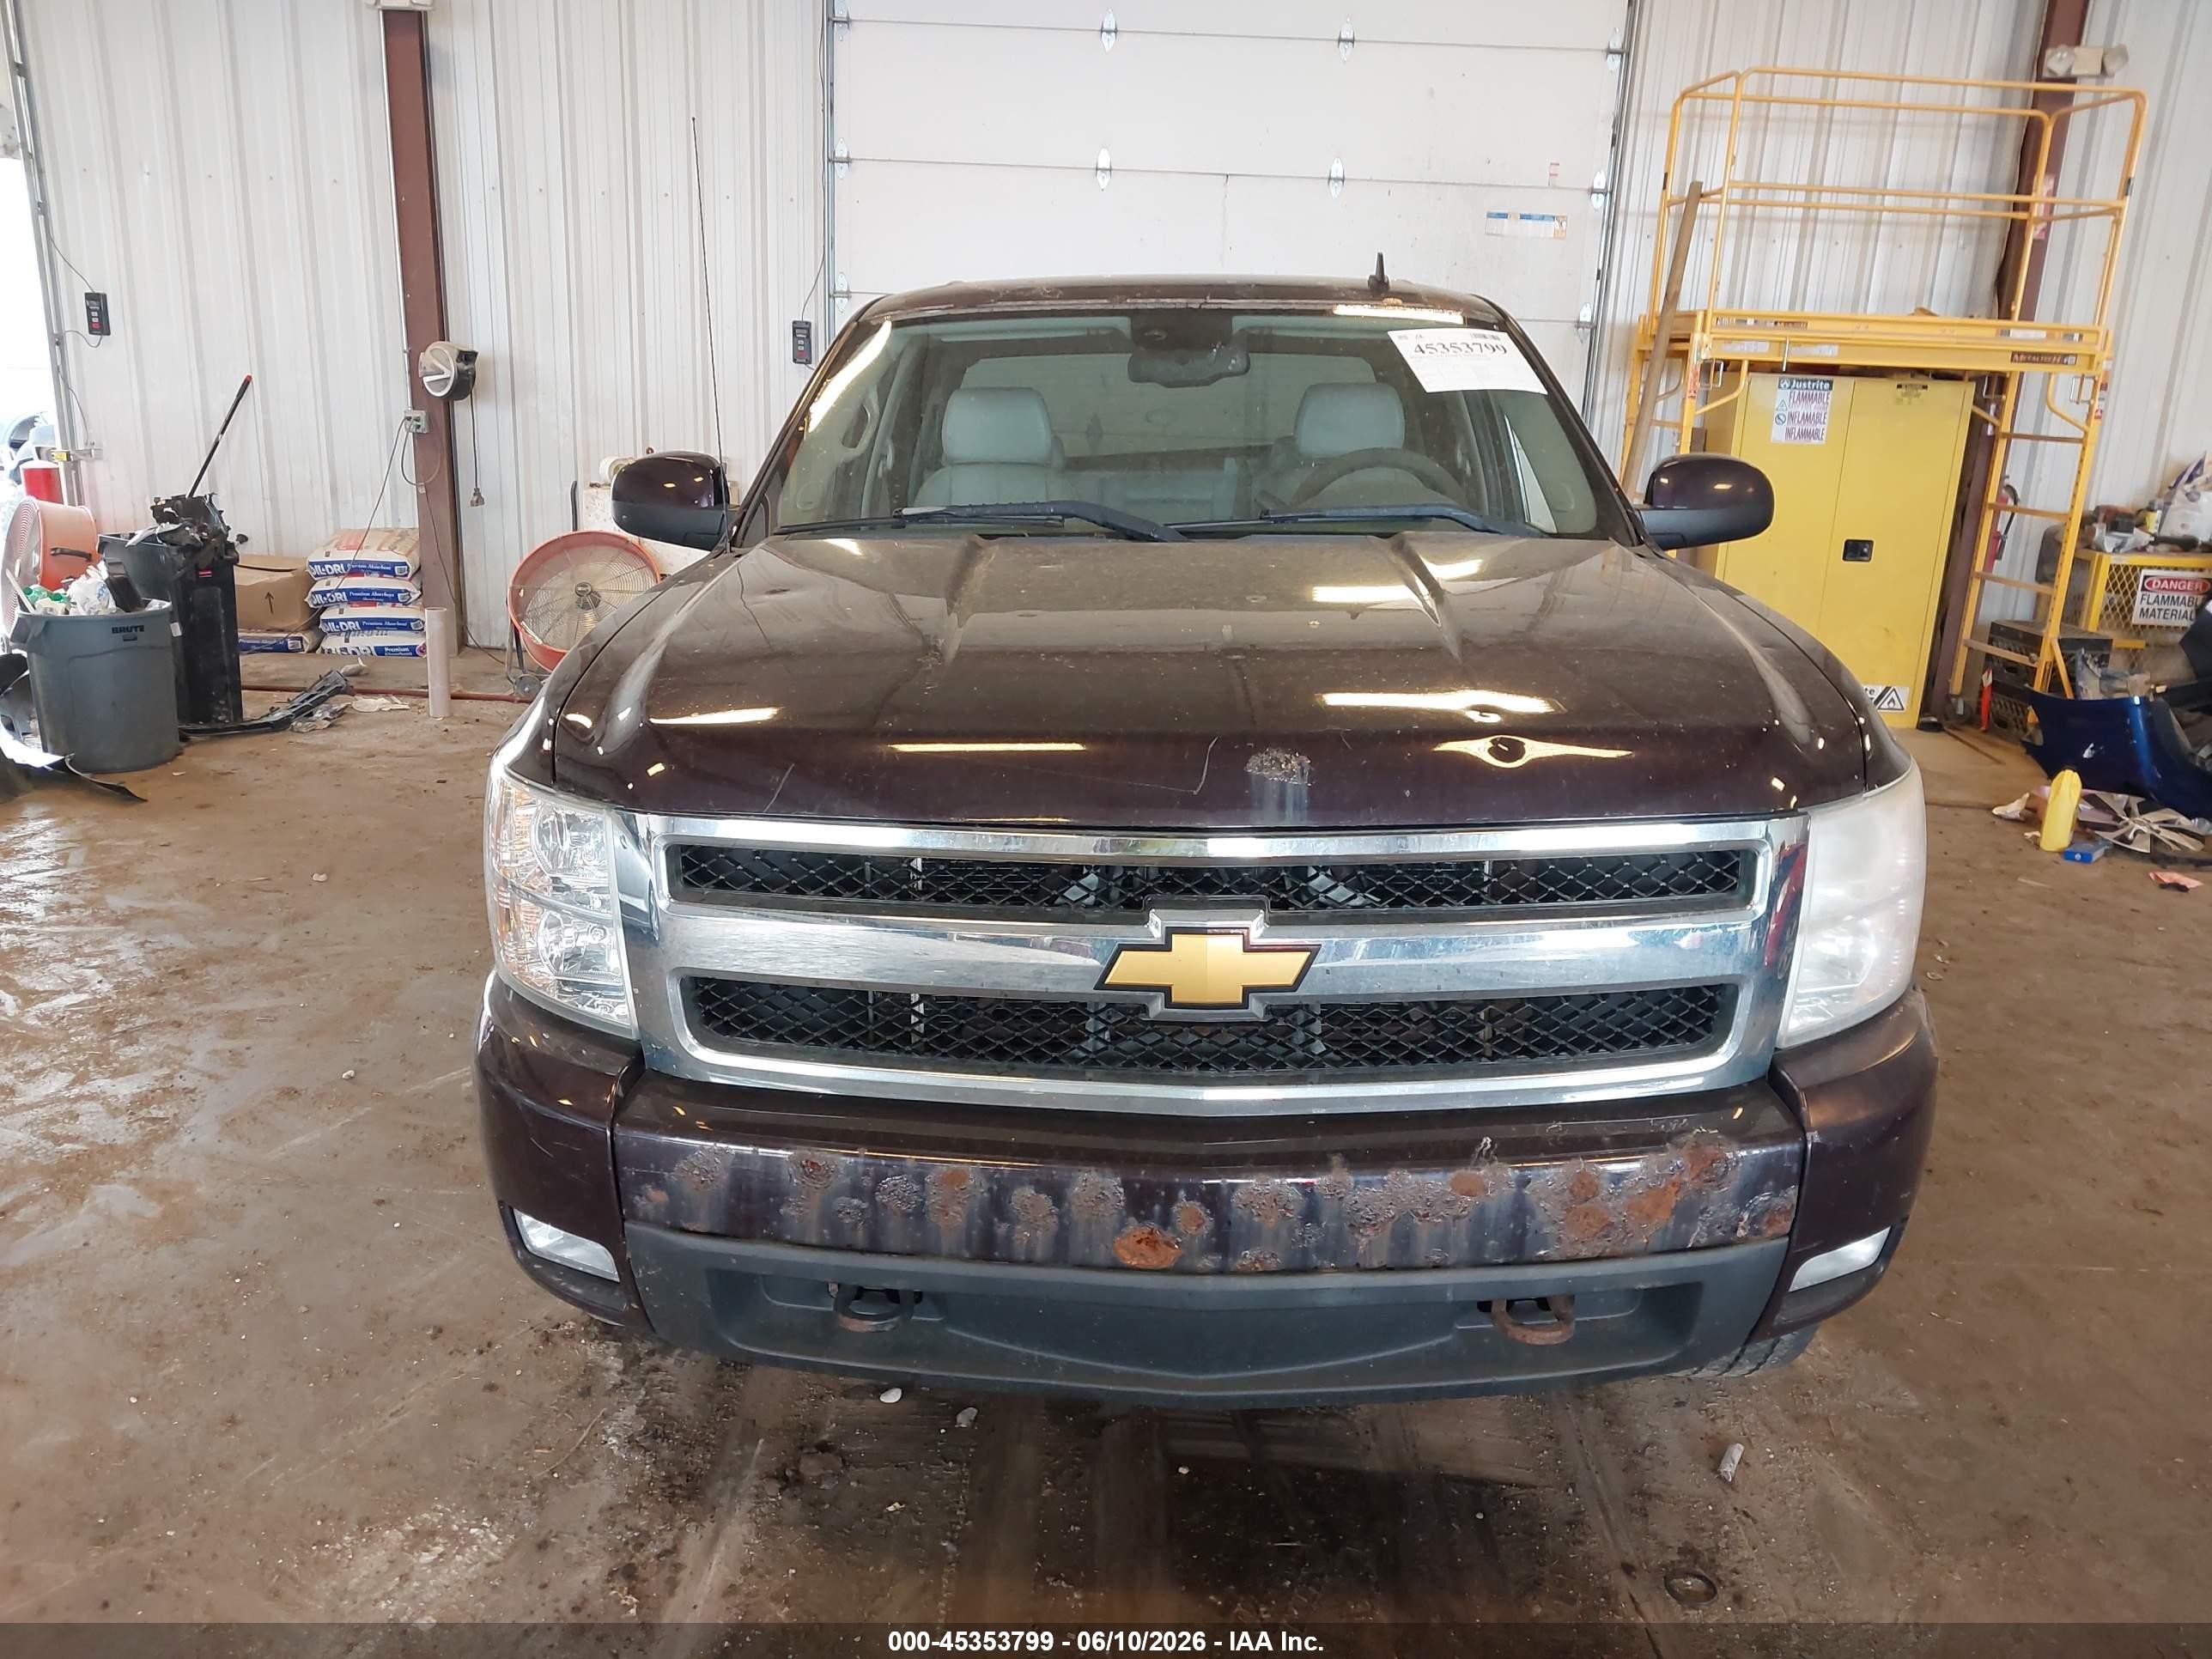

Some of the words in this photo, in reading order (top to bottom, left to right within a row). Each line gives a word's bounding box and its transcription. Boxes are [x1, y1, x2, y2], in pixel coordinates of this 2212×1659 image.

[1414, 343, 1507, 355] 45353799
[1791, 379, 1830, 390] Justrite
[1789, 392, 1830, 405] FLAMMABLE
[1787, 412, 1826, 425] INFLAMABLE
[1785, 428, 1825, 441] INFLAMMABLE
[2152, 580, 2203, 592] DANGER
[112, 625, 144, 634] BRUTE
